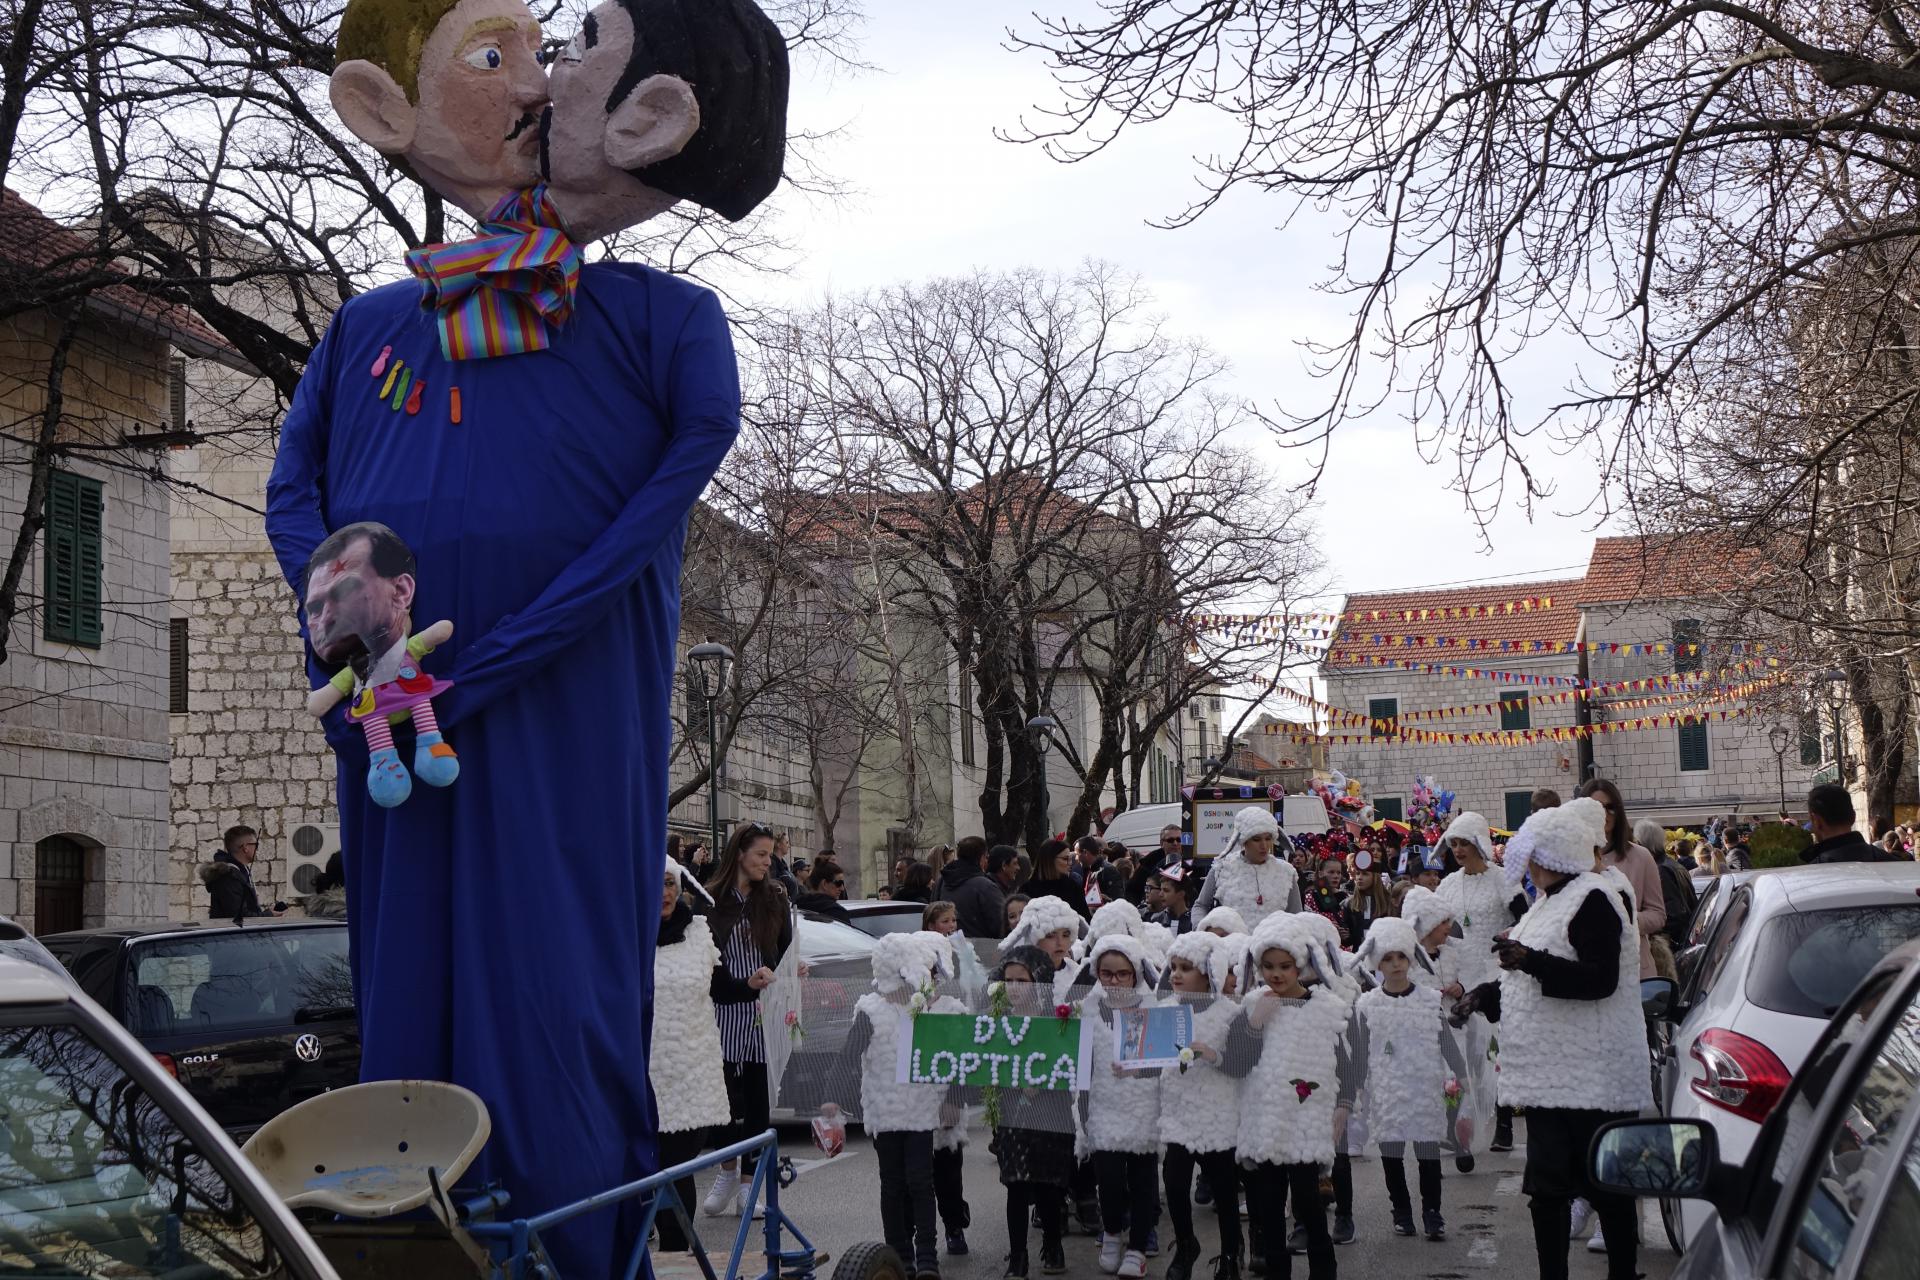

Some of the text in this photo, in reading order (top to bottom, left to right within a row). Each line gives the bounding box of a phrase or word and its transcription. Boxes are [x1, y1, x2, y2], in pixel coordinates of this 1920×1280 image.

[973, 1014, 1031, 1046] DV
[182, 1053, 219, 1065] GOLF
[912, 1048, 1077, 1092] LOPTICA
